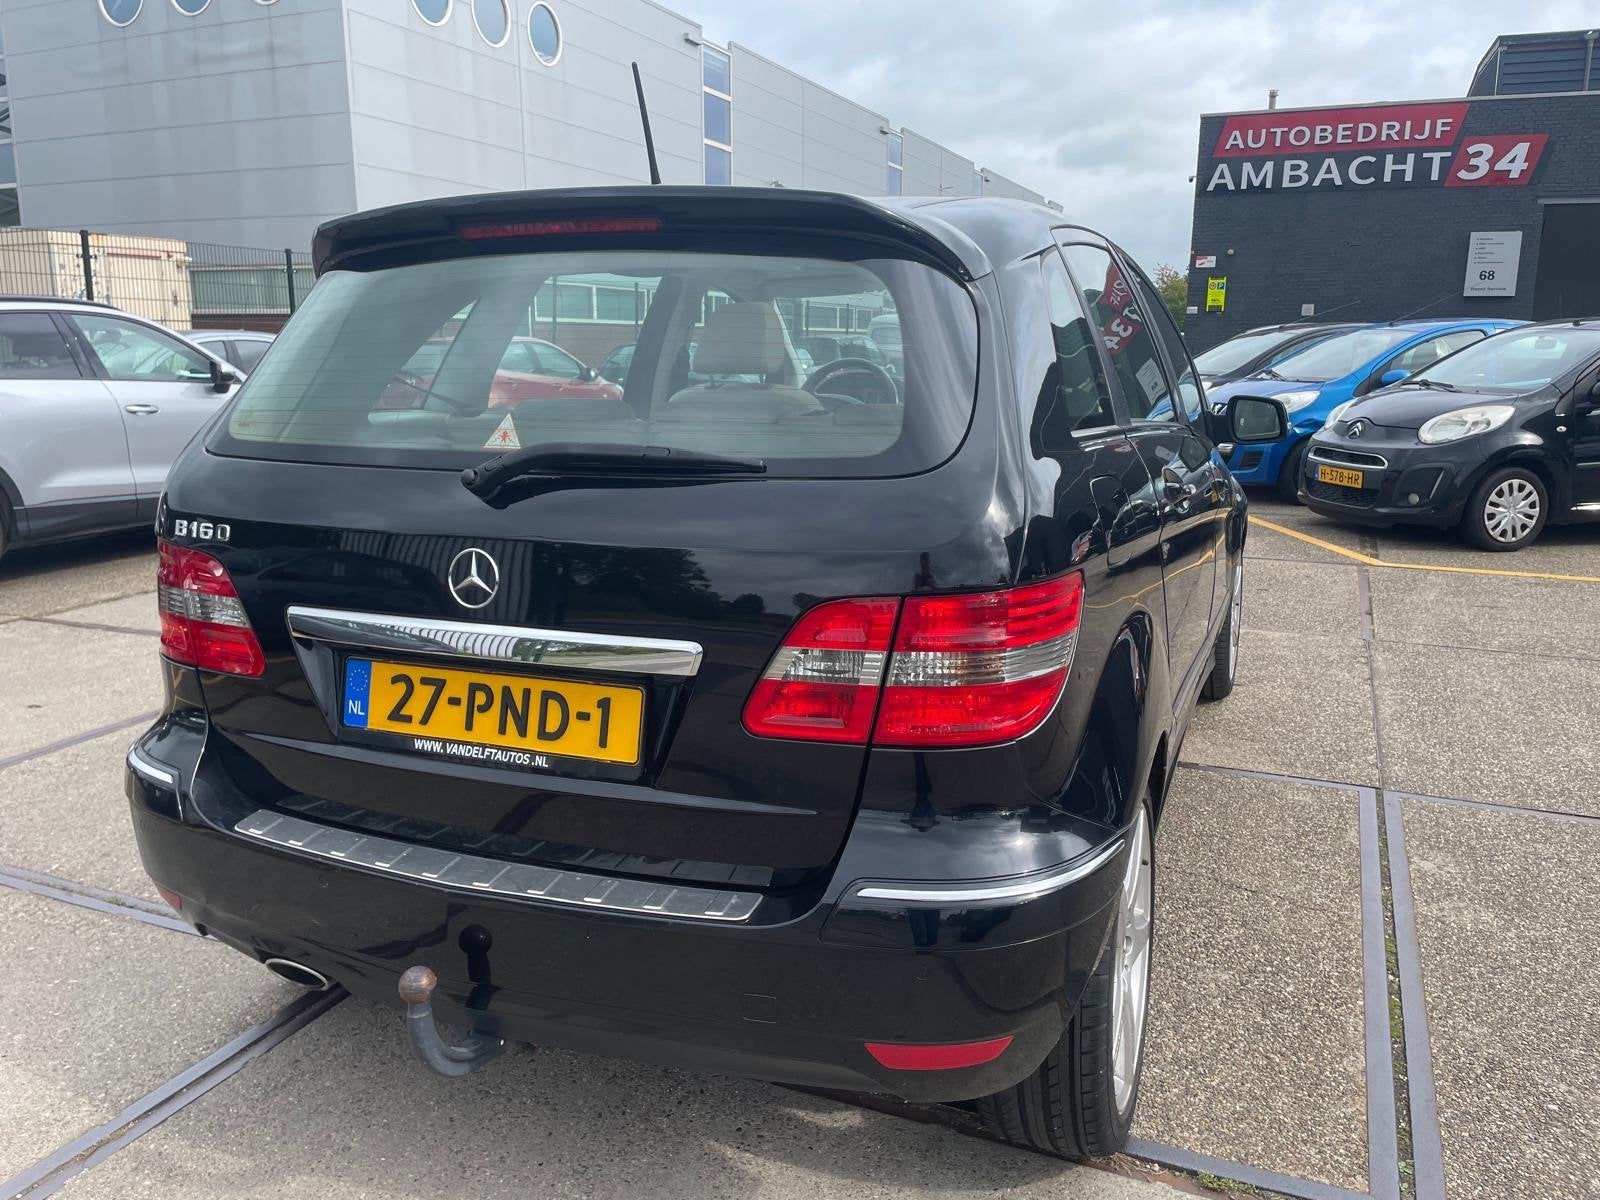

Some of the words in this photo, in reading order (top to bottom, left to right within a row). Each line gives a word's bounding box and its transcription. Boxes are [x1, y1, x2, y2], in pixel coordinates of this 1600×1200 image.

[1225, 118, 1453, 149] AUTOBEDRIJF
[1207, 151, 1452, 191] AMBACHT
[1456, 142, 1530, 181] 34
[1479, 270, 1495, 281] 68
[1320, 468, 1360, 486] H-578-HR
[174, 519, 231, 543] B160
[347, 699, 365, 718] NL
[387, 673, 613, 749] 27-PND-1
